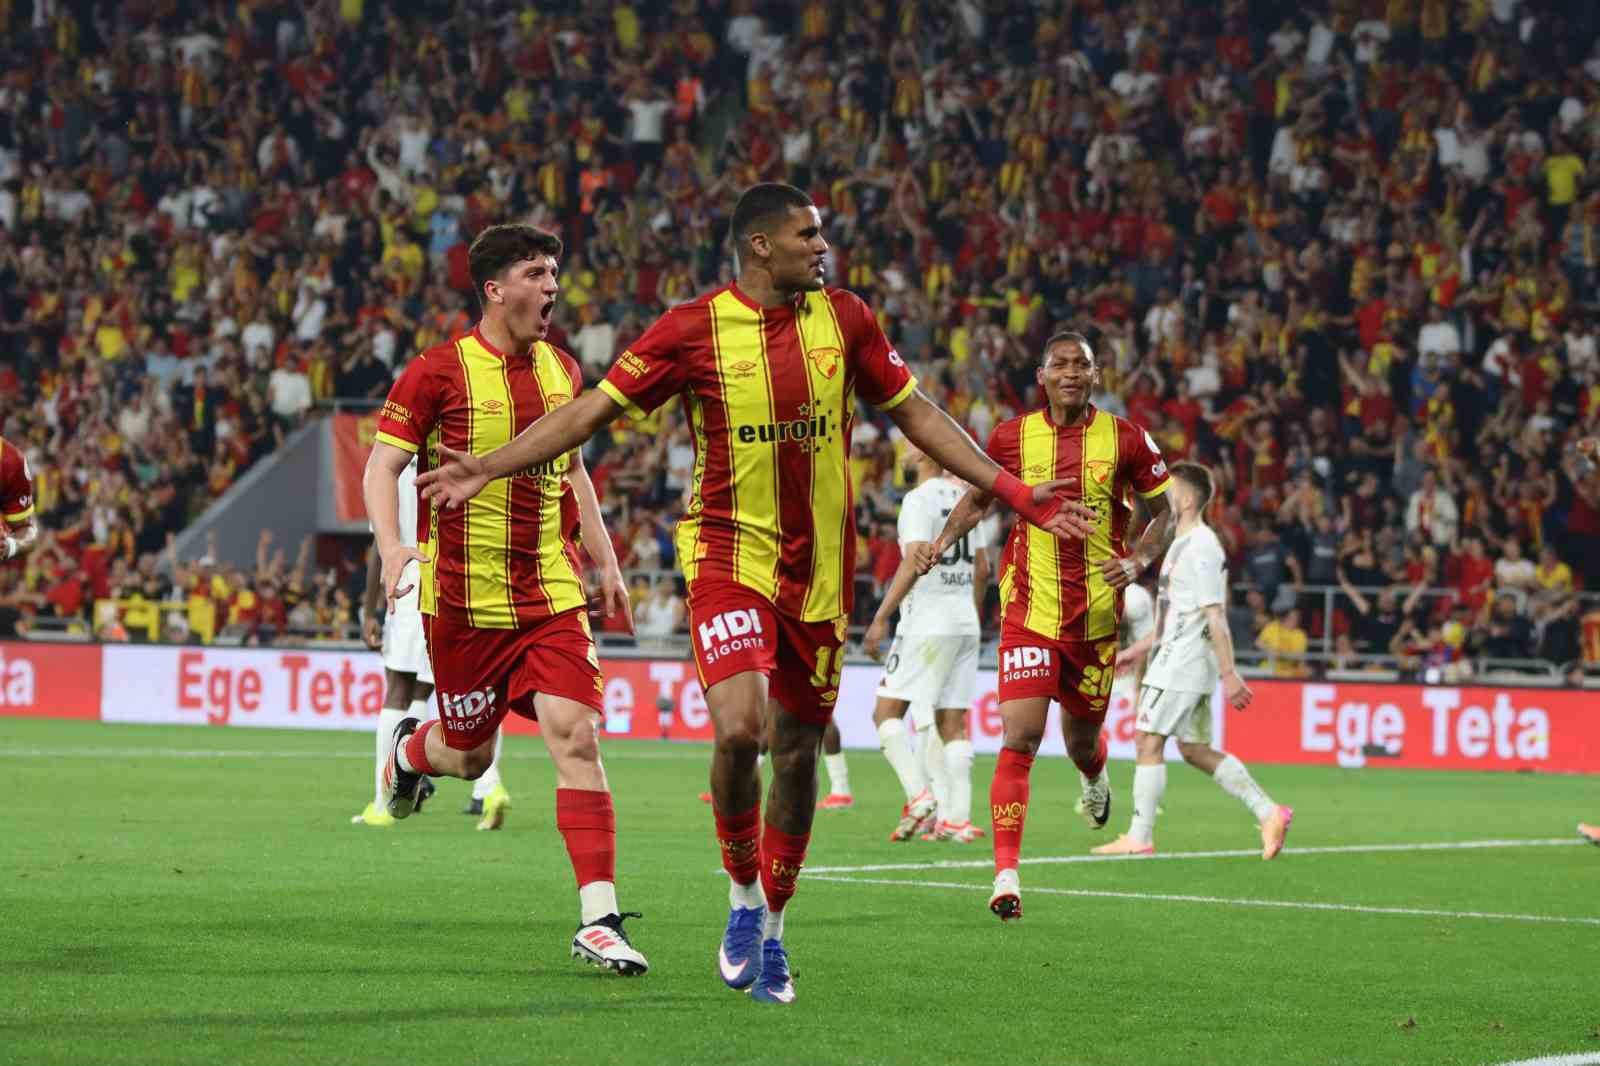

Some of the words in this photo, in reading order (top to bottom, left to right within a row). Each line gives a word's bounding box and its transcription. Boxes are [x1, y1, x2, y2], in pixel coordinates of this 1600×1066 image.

[738, 415, 826, 443] euroil
[698, 608, 762, 651] HDI
[1003, 646, 1051, 673] HDI
[177, 652, 262, 724] Ege
[280, 655, 384, 716] Teta
[442, 686, 496, 718] HDI
[649, 661, 712, 729] Te
[1301, 684, 1406, 768] Ege
[1421, 690, 1550, 760] Teta
